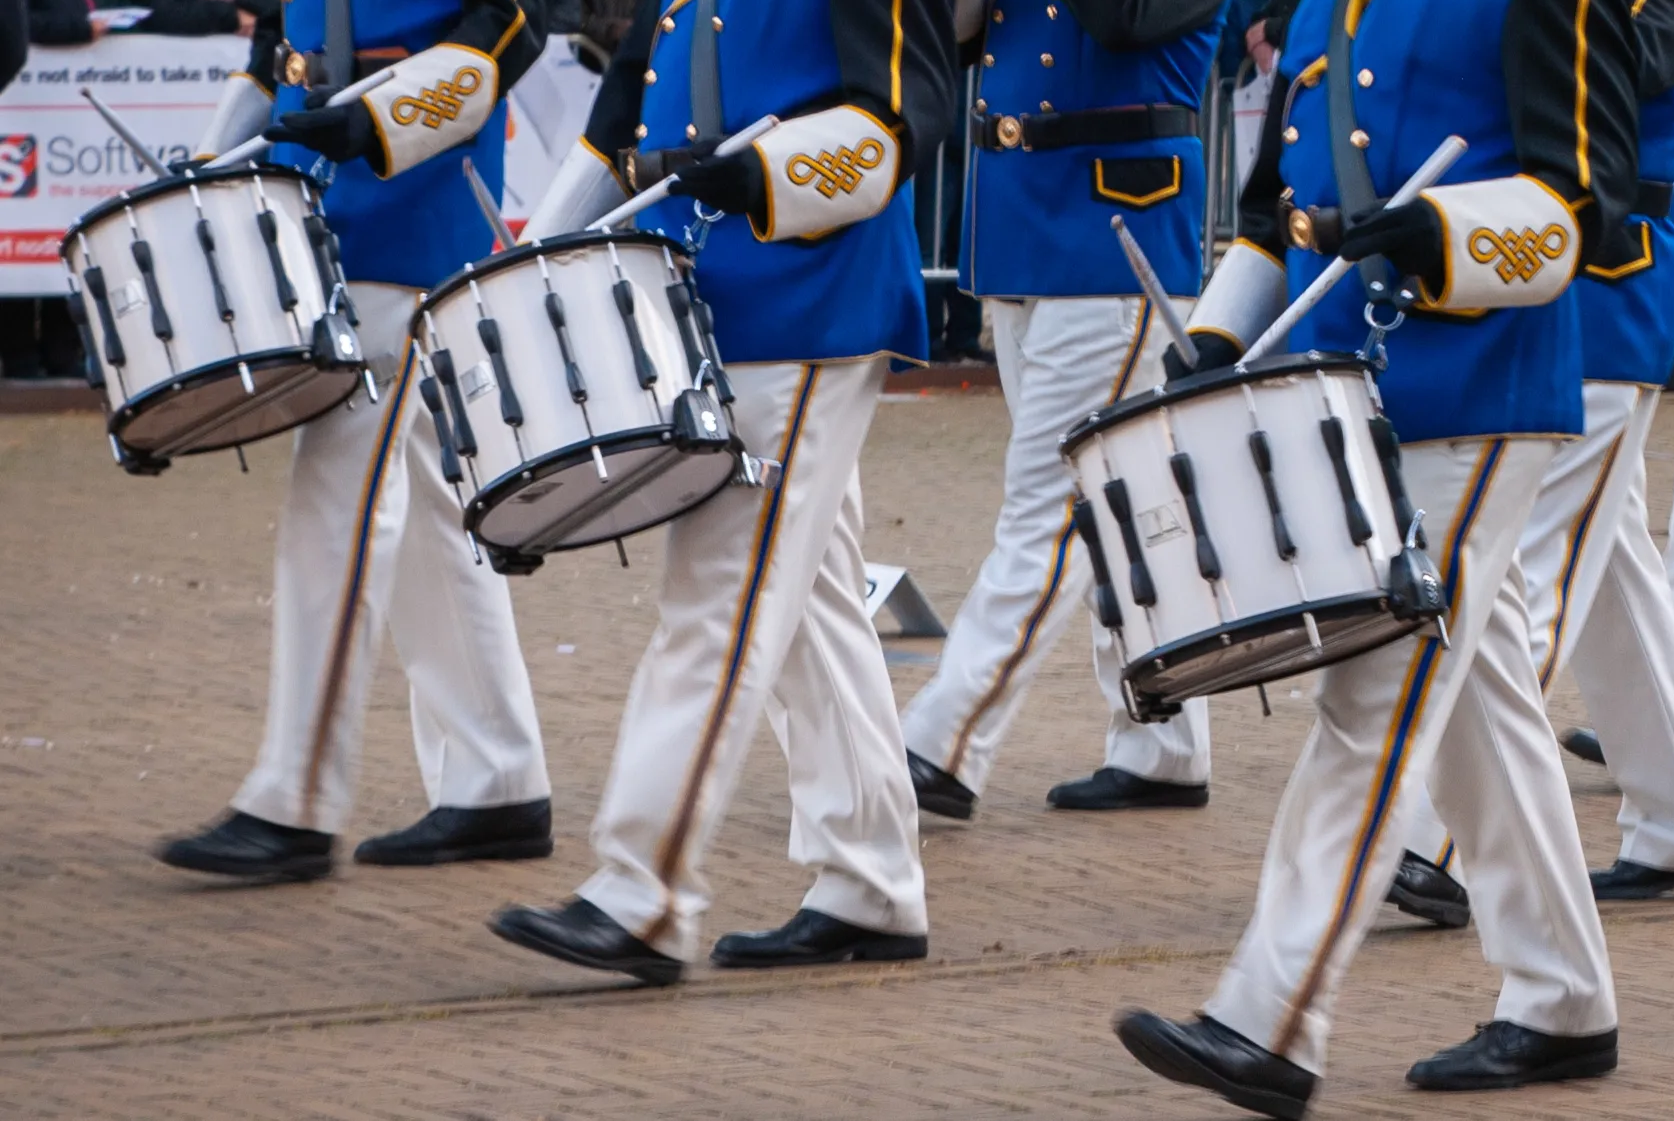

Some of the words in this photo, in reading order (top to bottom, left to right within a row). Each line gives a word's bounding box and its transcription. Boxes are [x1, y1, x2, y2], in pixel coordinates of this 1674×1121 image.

[38, 67, 68, 82] not
[76, 66, 130, 82] afraid
[137, 67, 155, 82] to
[162, 66, 201, 82] take
[46, 136, 193, 176] Softwa
